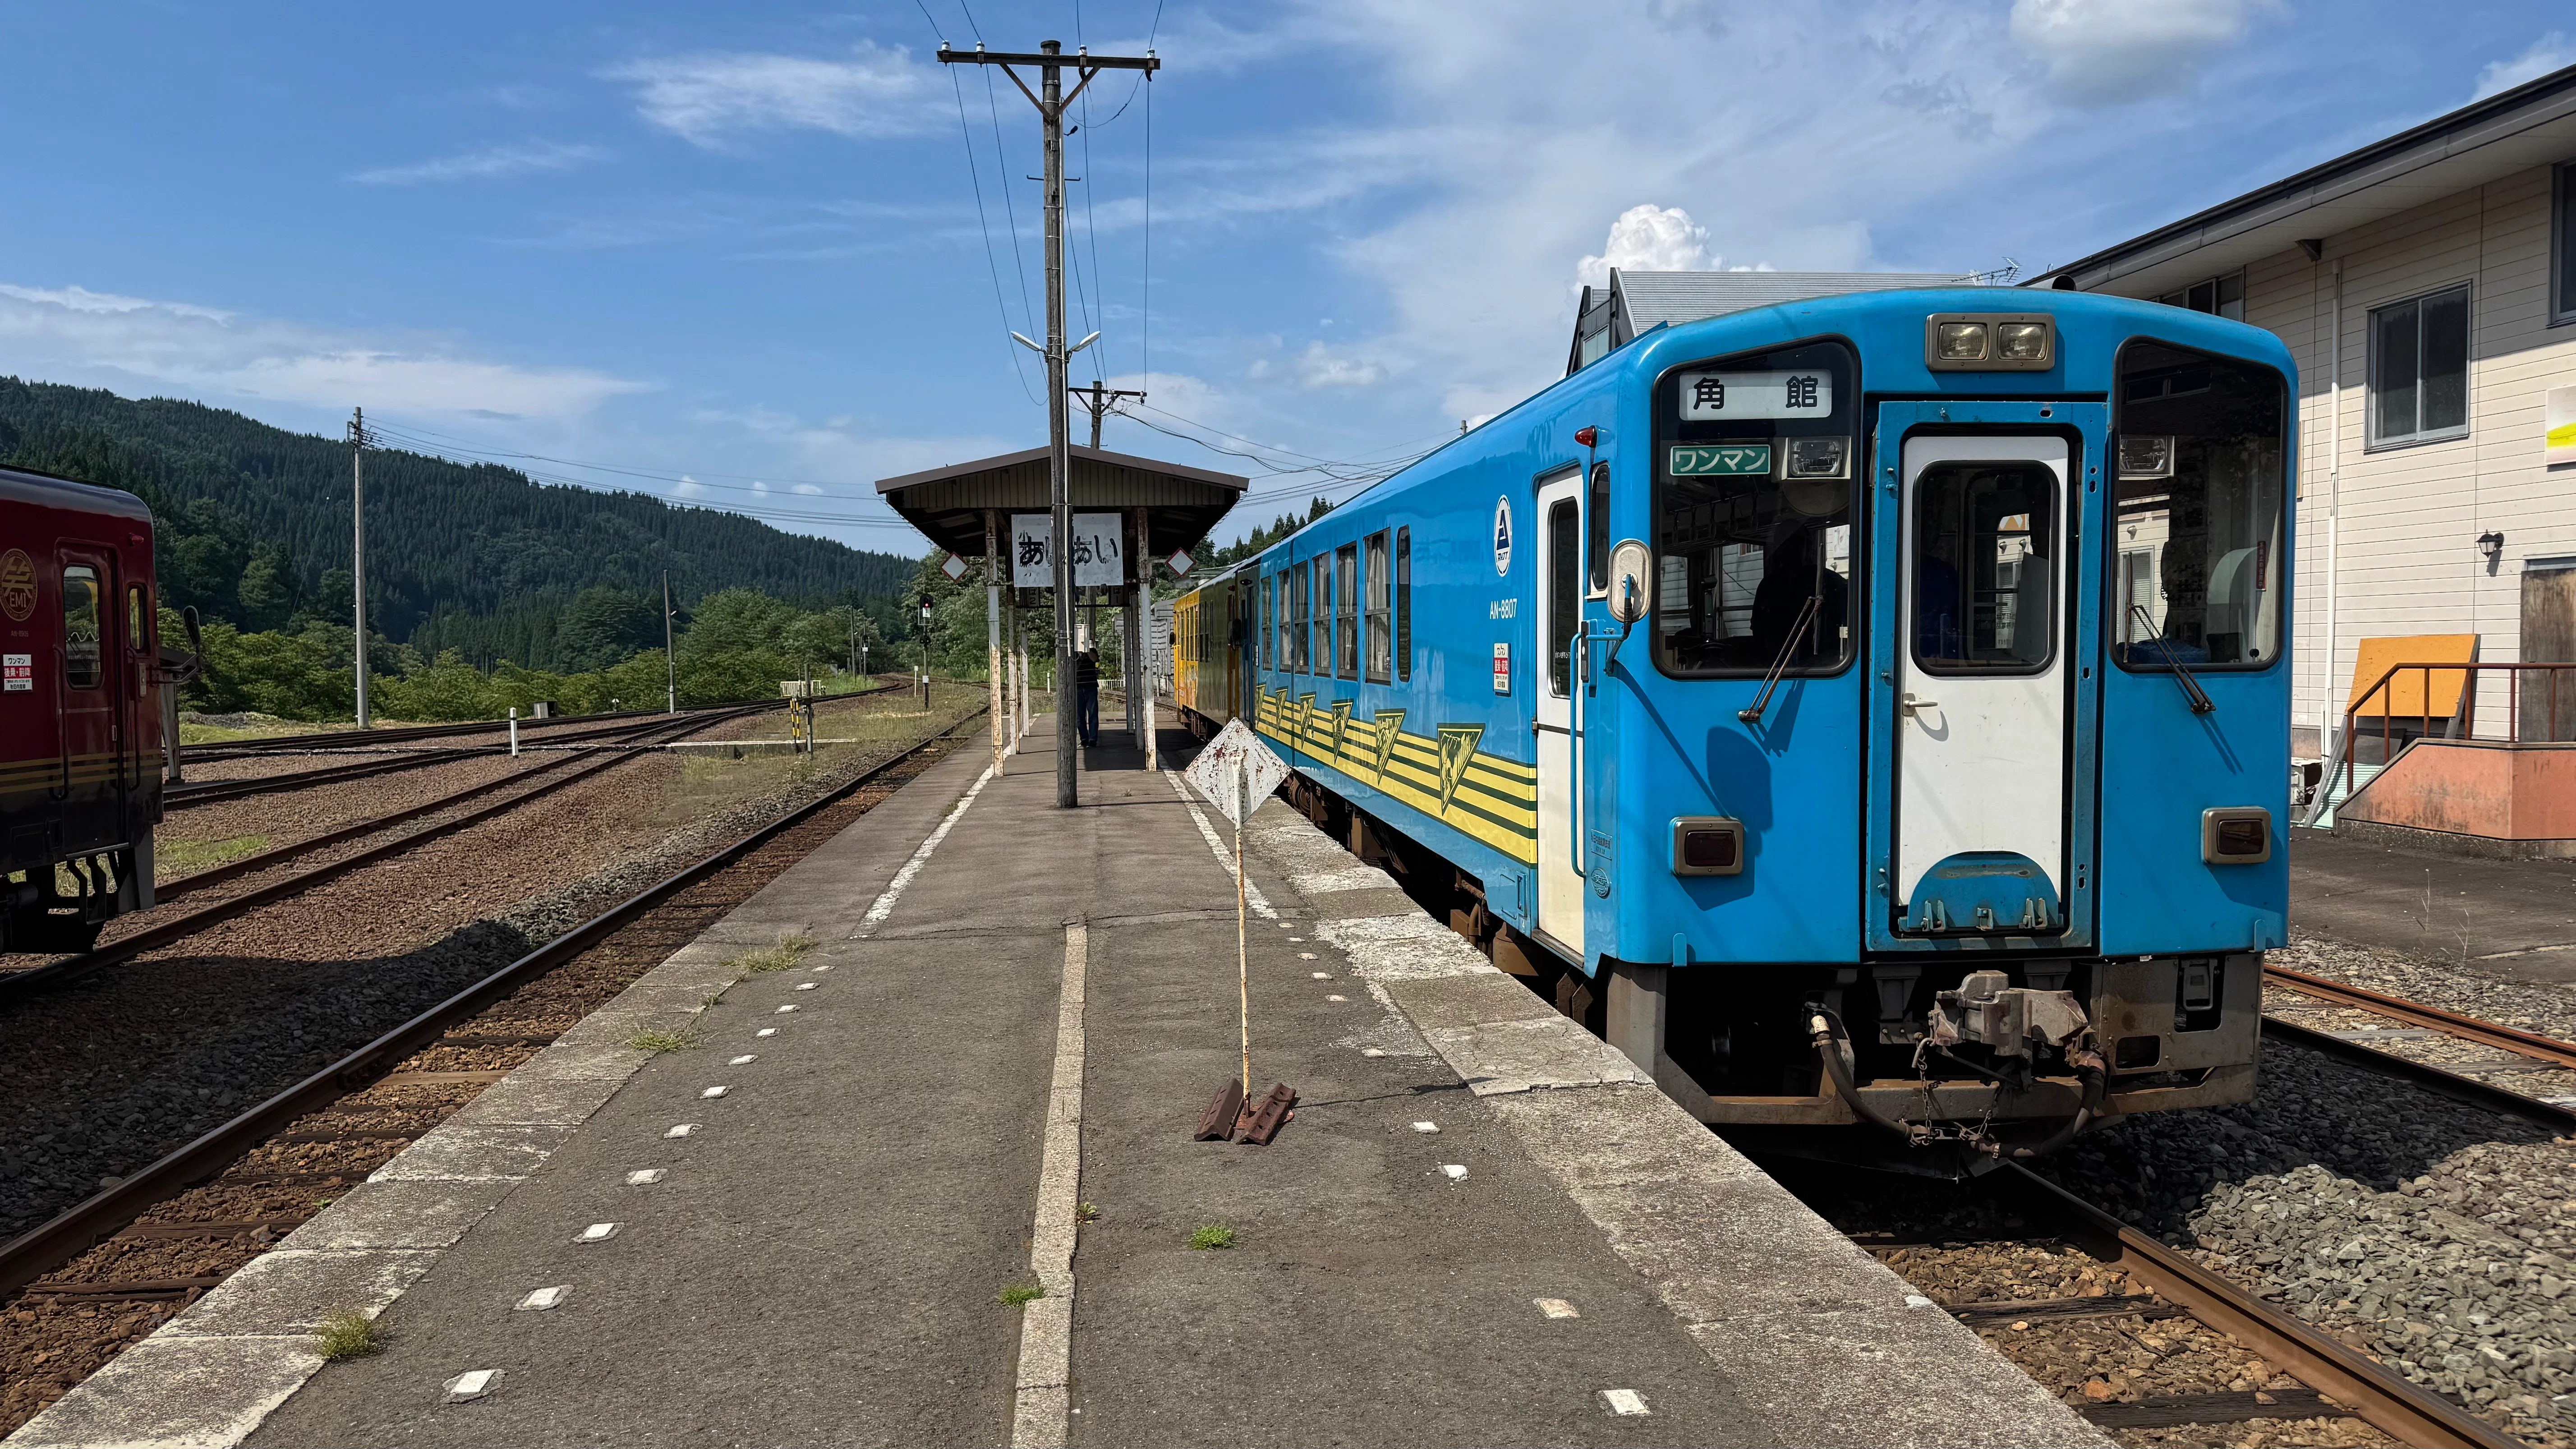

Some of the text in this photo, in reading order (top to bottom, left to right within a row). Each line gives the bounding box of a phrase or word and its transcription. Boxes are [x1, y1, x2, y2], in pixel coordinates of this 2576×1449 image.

[1693, 375, 1818, 410] 角館
[1675, 449, 1766, 472] ワンマン
[9, 592, 27, 607] EMI
[1490, 598, 1517, 620] AN-8807
